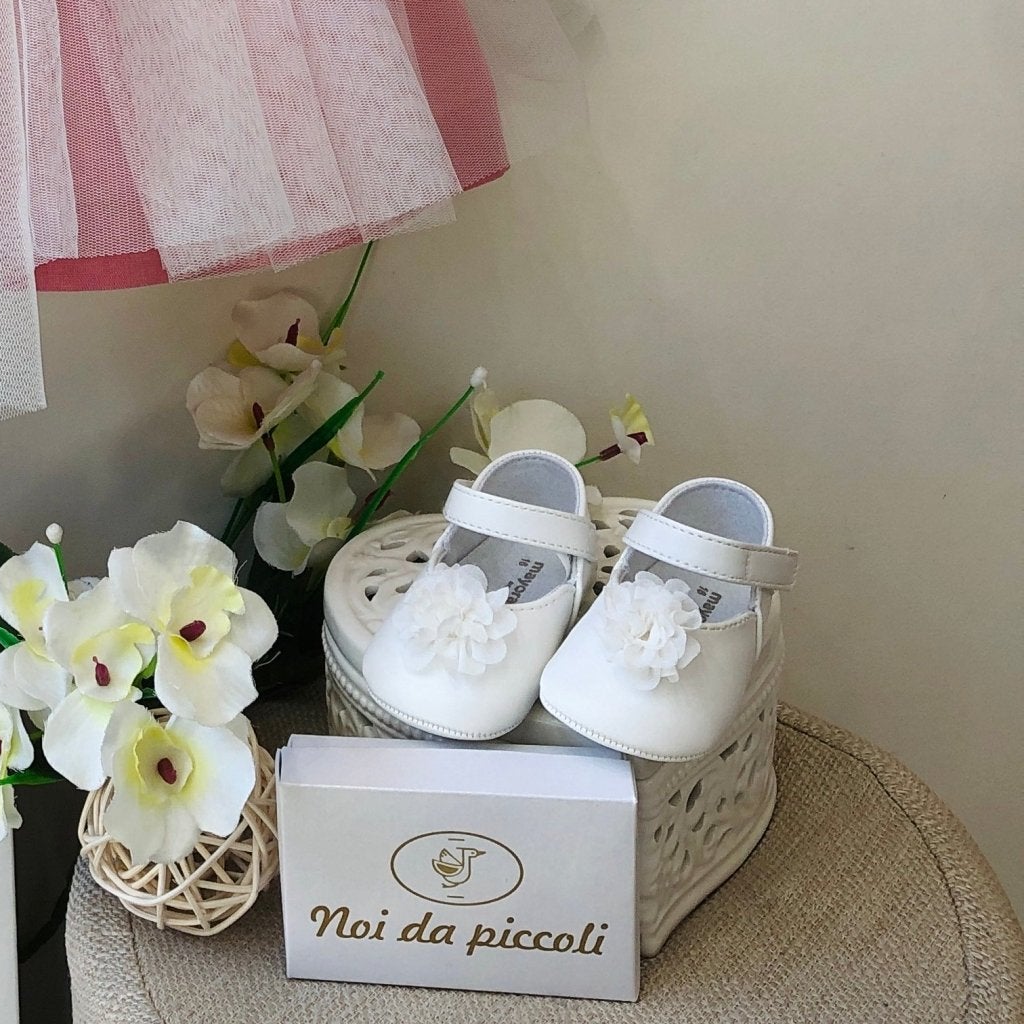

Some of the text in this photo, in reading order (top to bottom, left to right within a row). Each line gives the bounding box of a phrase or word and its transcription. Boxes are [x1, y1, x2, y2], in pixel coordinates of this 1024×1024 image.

[310, 905, 609, 956] Noi da piccoli
